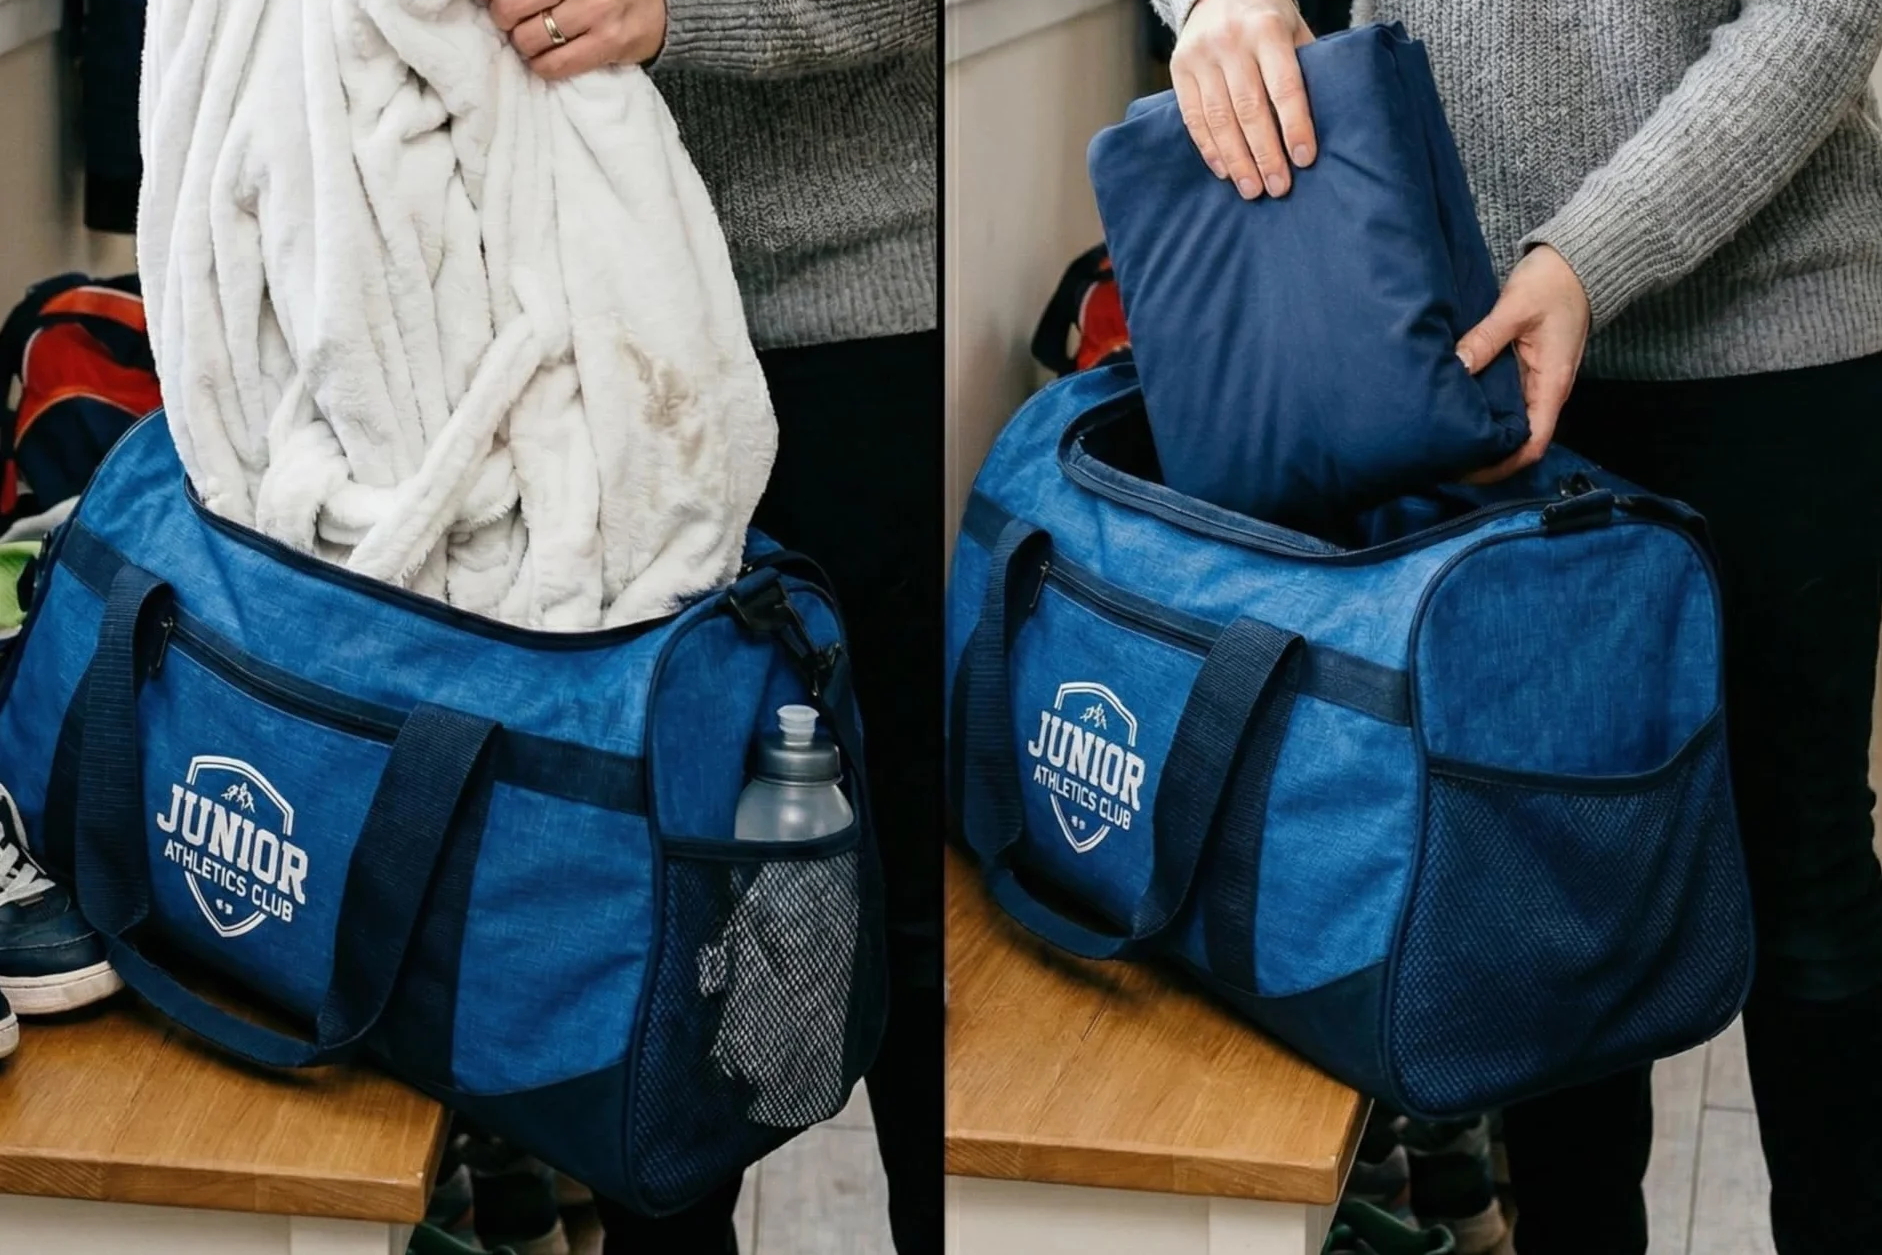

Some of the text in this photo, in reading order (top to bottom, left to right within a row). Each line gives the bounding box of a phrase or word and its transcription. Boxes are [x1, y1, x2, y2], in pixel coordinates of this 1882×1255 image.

[1027, 710, 1146, 812] JUNIOR
[1033, 764, 1132, 831] ATHLETICS CLUB
[156, 783, 309, 905] JUNIOR
[164, 838, 294, 923] ATHLETICS CLUB
